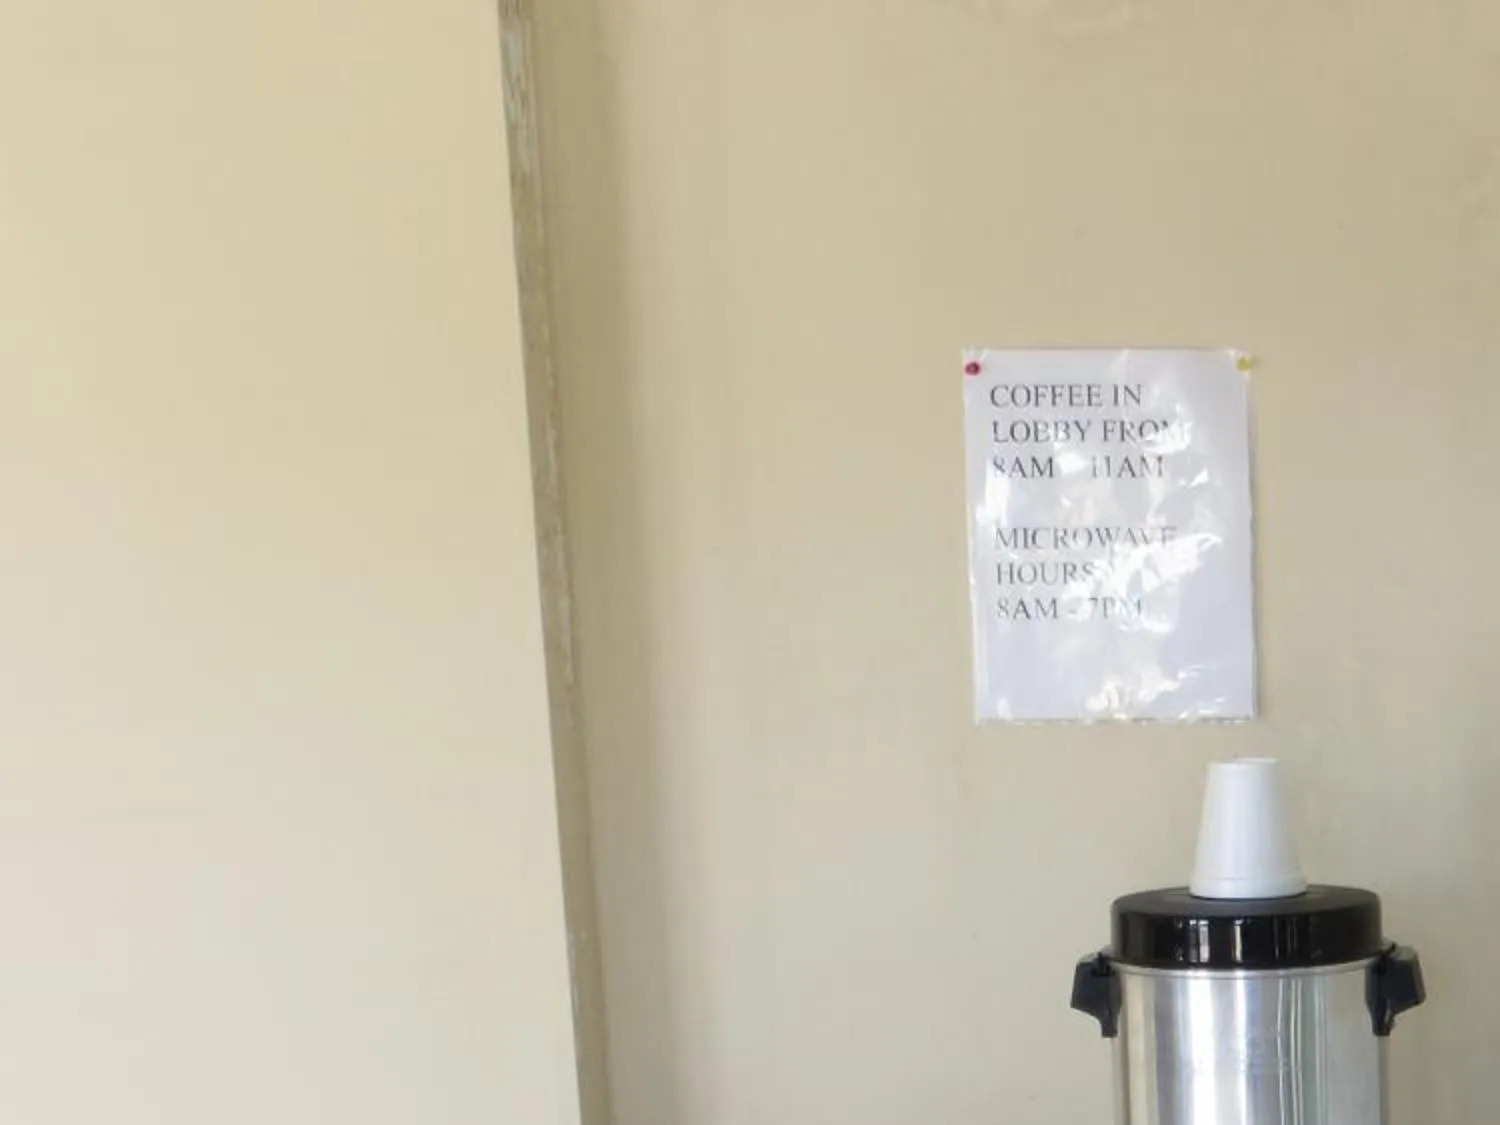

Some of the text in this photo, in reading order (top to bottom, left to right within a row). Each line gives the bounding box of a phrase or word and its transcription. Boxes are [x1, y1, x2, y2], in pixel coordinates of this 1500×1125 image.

[990, 383, 1142, 407] COFFEE IN
[992, 420, 1091, 443] LOBBY
[997, 562, 1093, 585] HOURS
[997, 598, 1058, 620] 8AM
